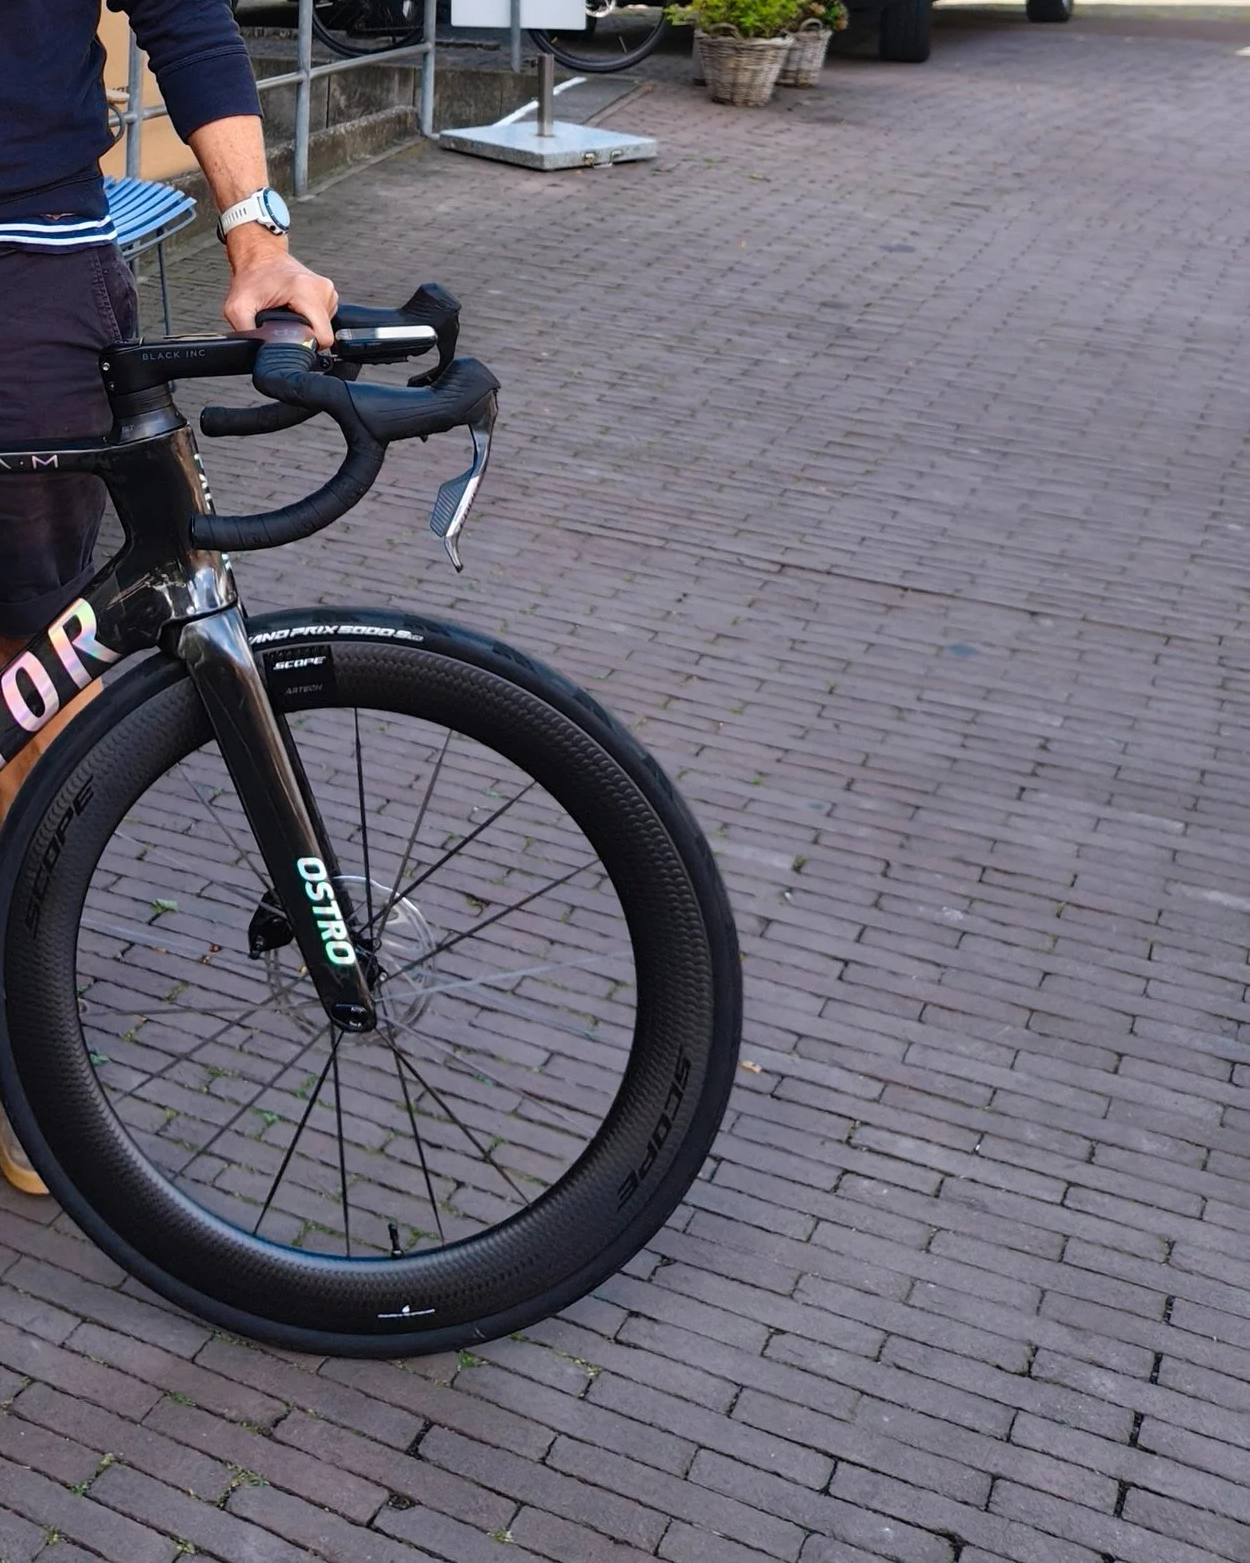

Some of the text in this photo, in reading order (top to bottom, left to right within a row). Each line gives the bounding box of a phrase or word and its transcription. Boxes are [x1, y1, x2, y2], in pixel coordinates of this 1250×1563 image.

[142, 349, 206, 361] BLACK INC
[289, 625, 339, 638] PRIX
[337, 625, 394, 637] 5000
[273, 656, 327, 671] SCOPE
[285, 684, 323, 695] ARTECH
[297, 857, 356, 966] OSTRO
